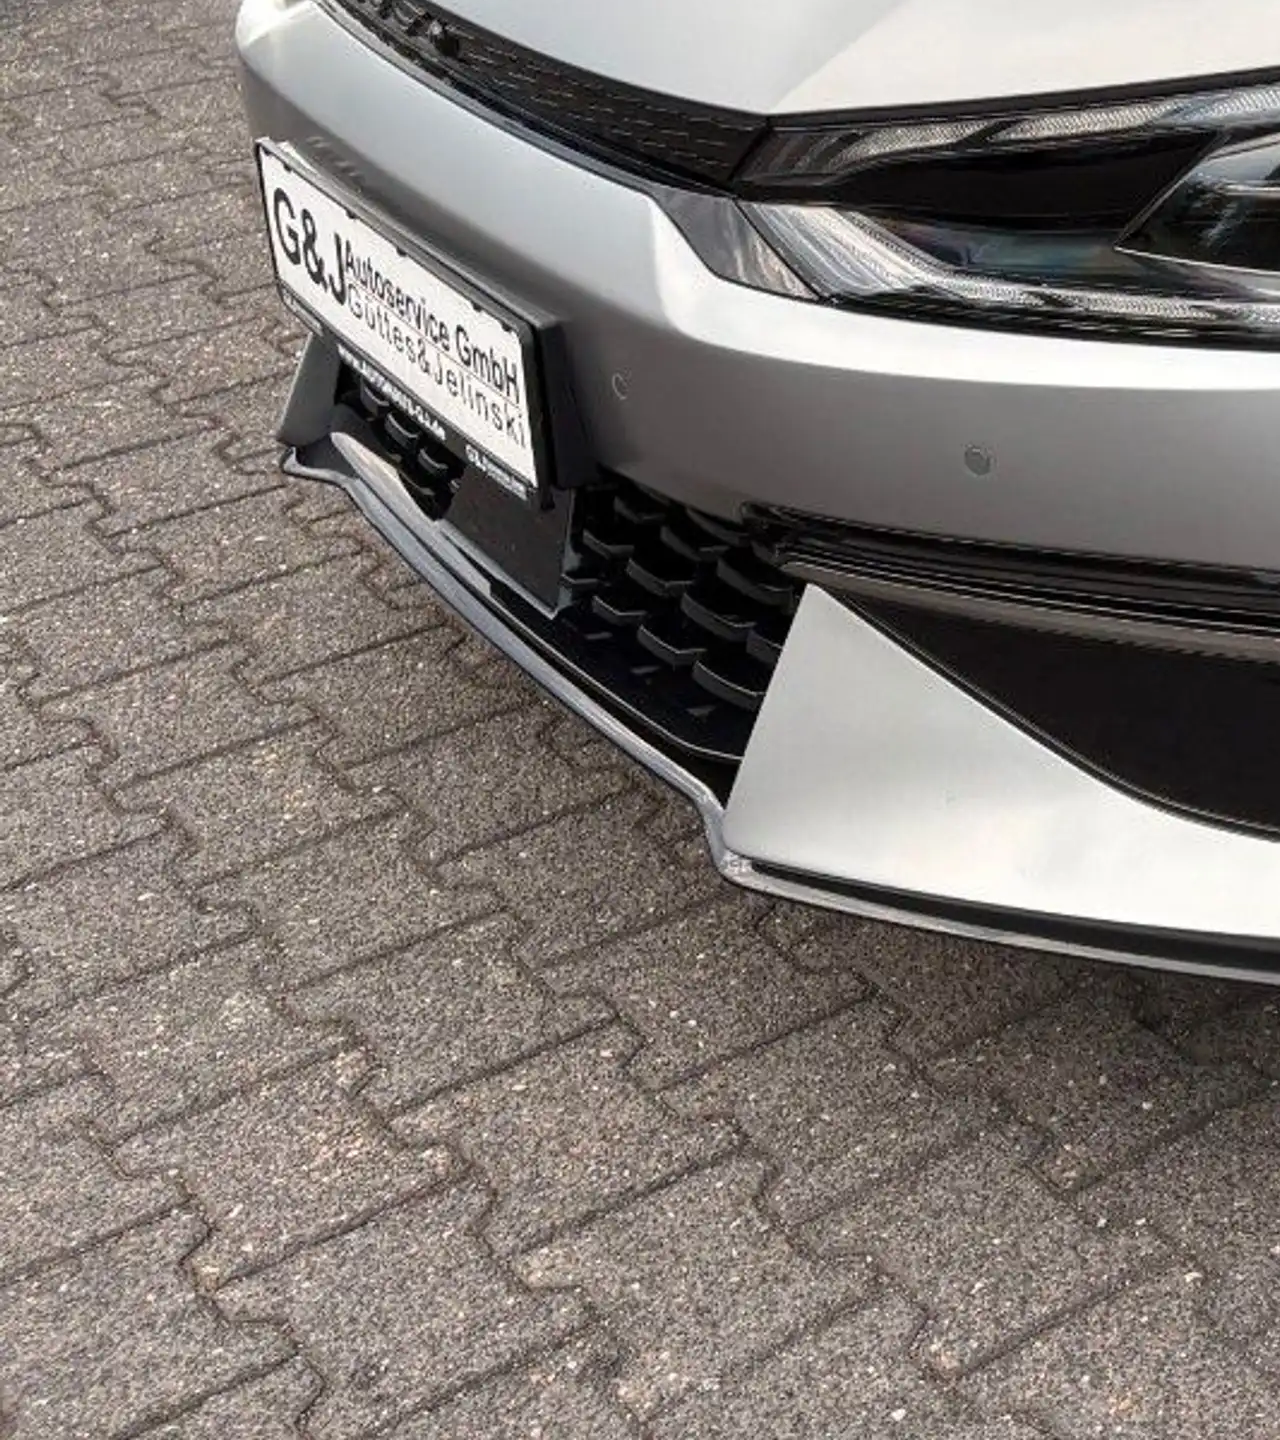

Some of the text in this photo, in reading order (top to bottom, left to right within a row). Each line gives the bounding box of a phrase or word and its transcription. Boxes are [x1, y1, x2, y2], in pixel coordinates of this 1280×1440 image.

[273, 186, 346, 306] G&J
[345, 239, 451, 352] Autoservice
[456, 324, 521, 404] GmbH
